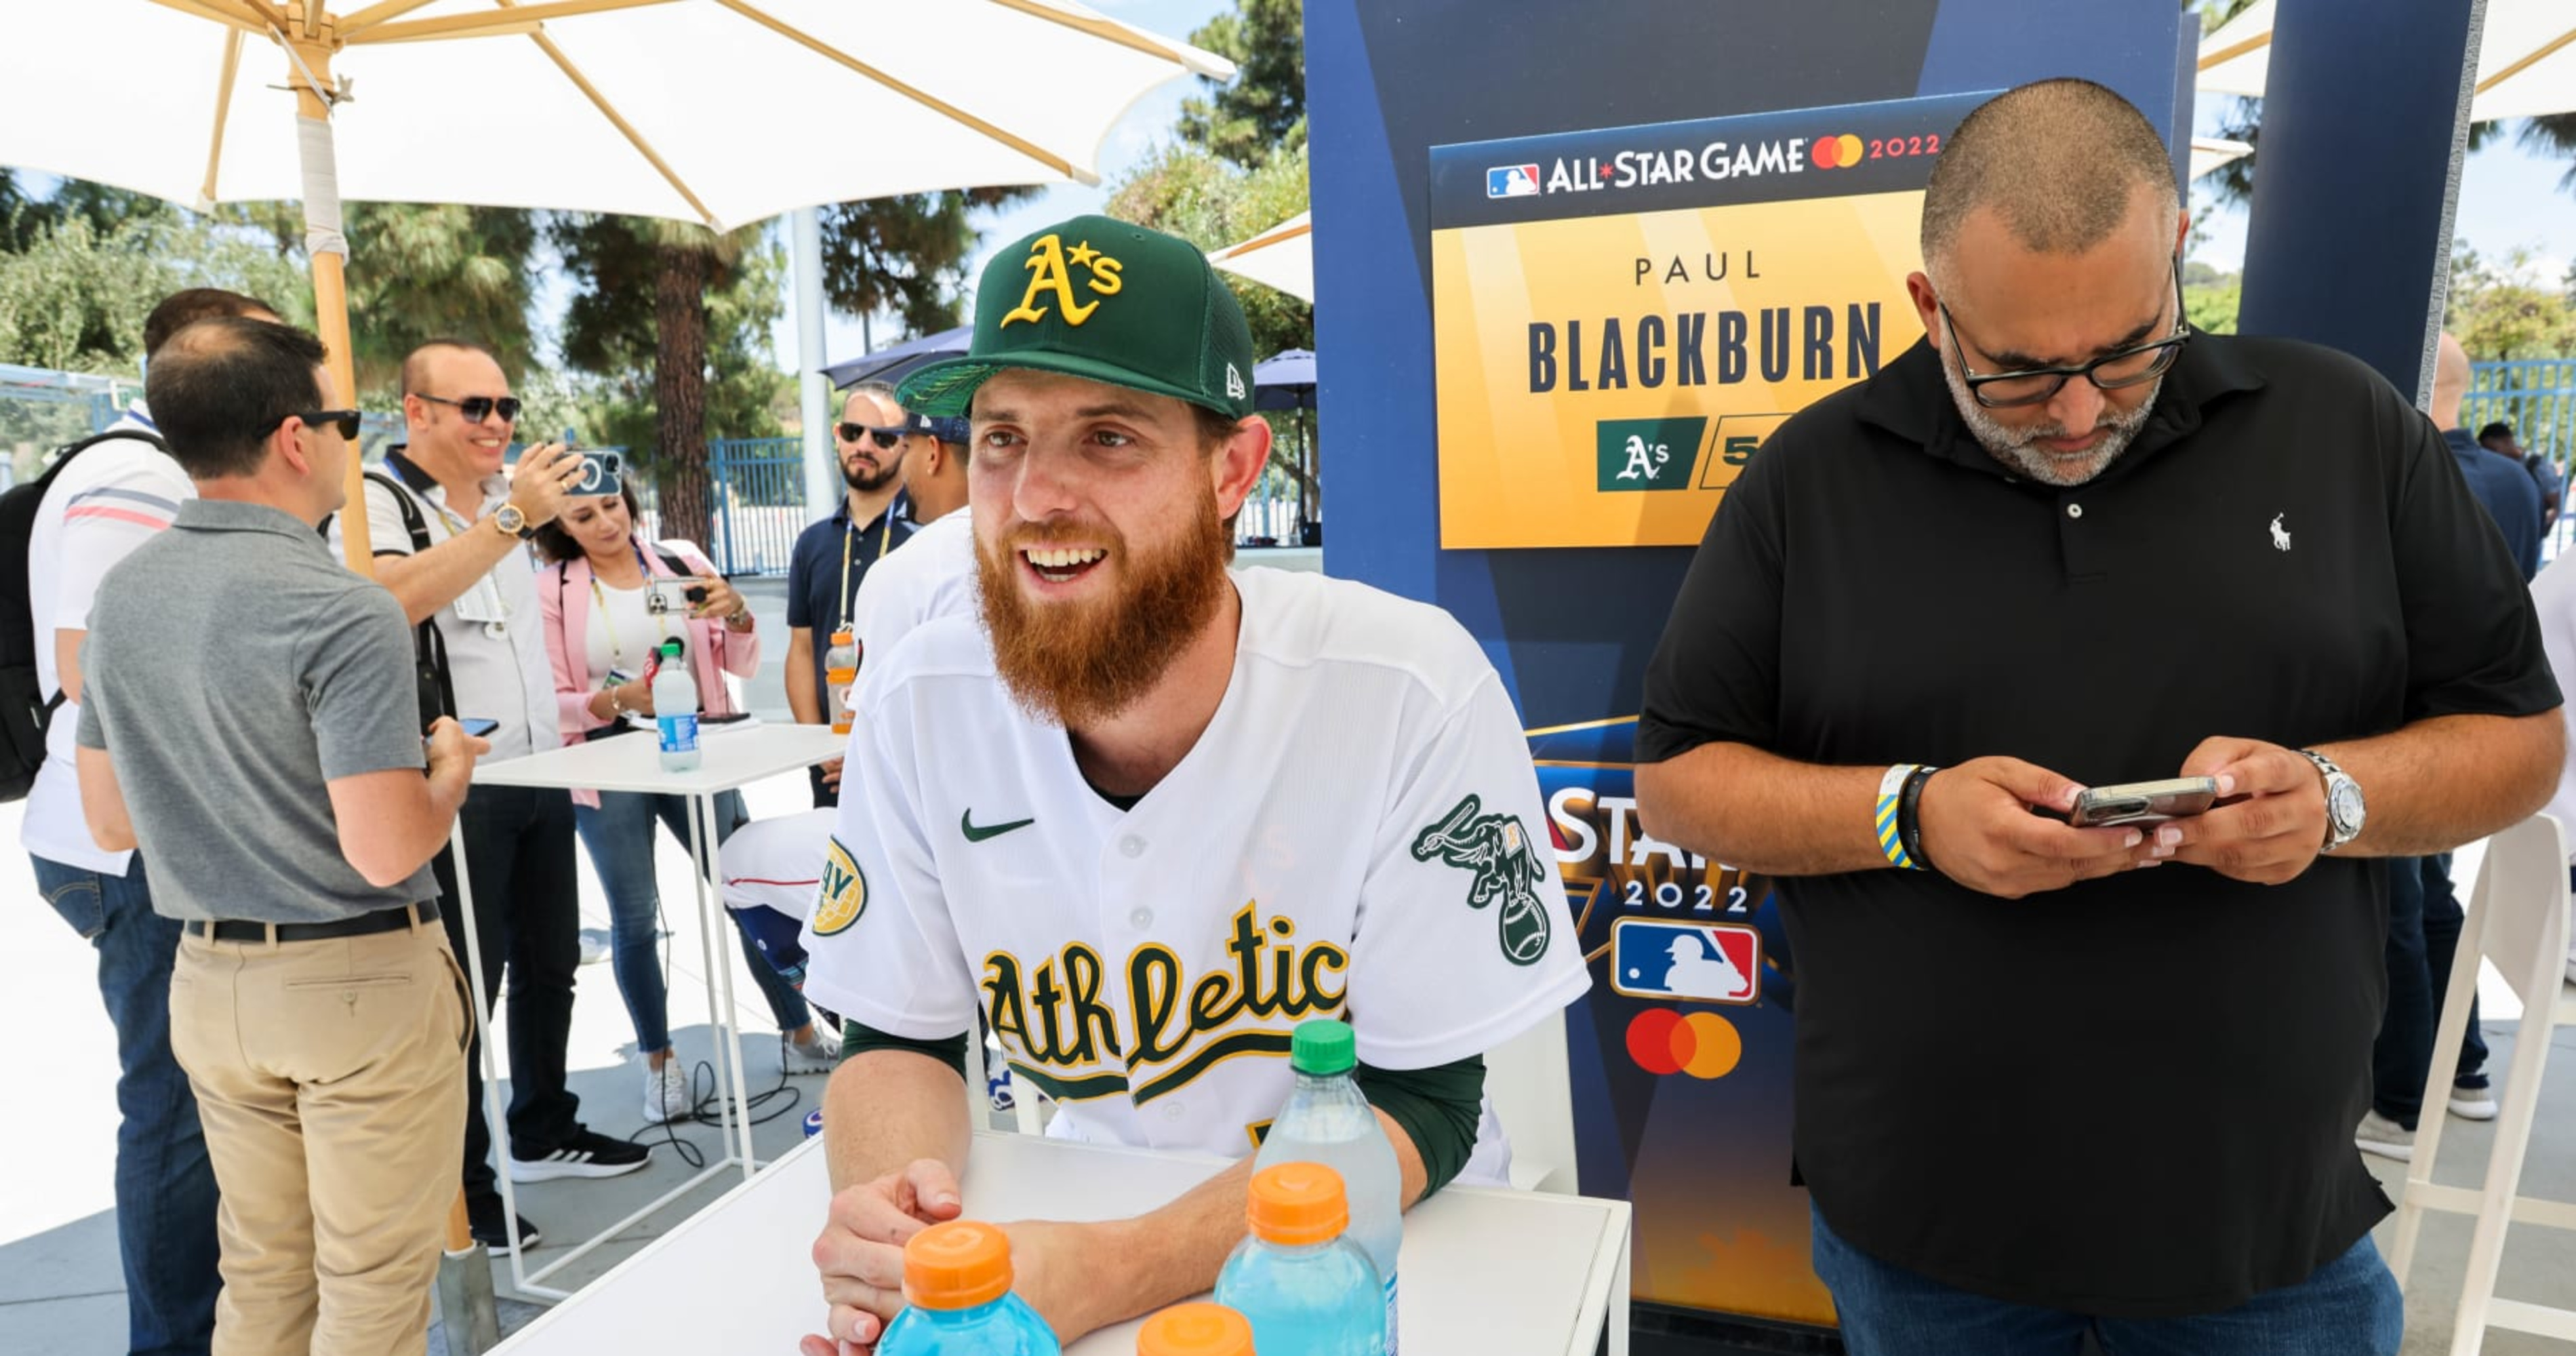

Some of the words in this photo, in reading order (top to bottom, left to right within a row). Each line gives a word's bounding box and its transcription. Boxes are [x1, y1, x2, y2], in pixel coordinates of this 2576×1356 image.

[1699, 138, 1805, 180] GAME
[1870, 134, 1939, 159] 2022
[1636, 250, 1760, 286] PAUL
[1528, 302, 1881, 393] BLACKBURN
[1616, 435, 1670, 481] A's
[1624, 880, 1748, 913] 2022
